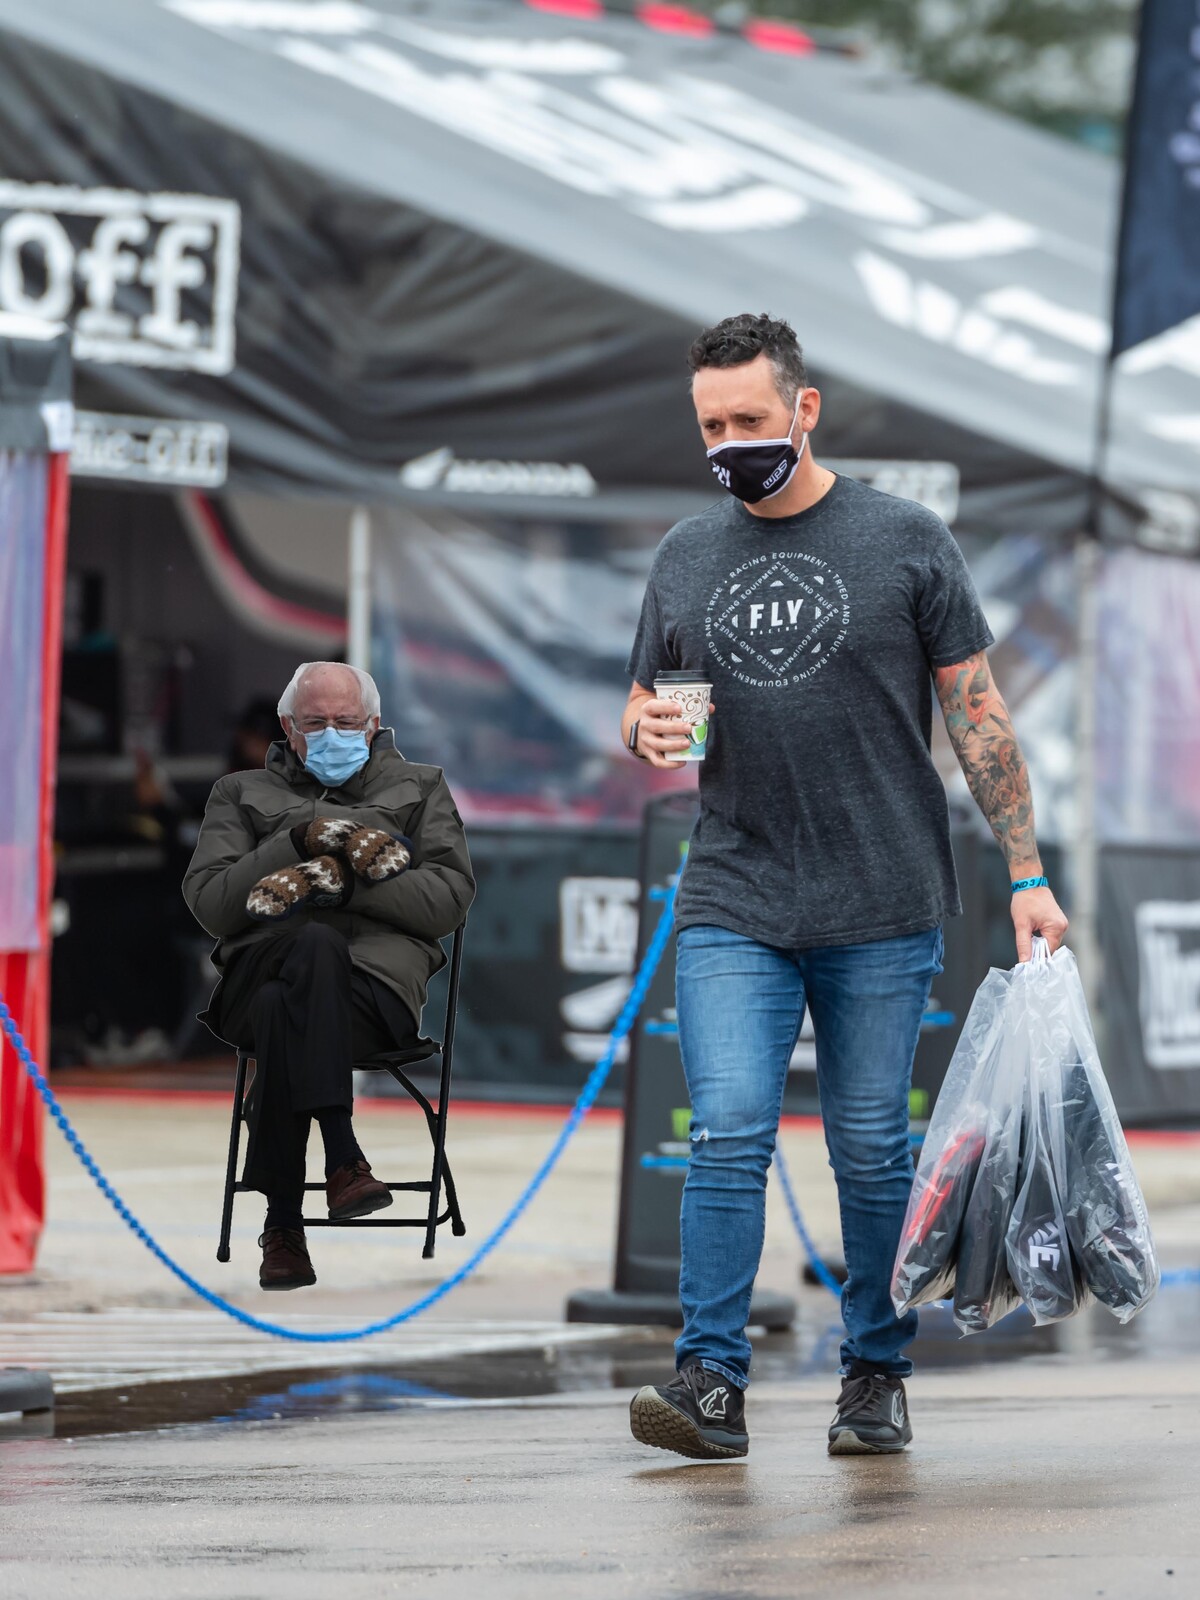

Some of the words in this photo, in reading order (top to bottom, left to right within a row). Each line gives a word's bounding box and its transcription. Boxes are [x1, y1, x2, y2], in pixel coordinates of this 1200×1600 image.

[729, 555, 768, 579] RACING
[772, 552, 828, 569] EQUIPMENT
[713, 600, 740, 628] RACING
[740, 561, 782, 600] EQUIPMENT
[780, 565, 800, 583] TRIED
[799, 581, 814, 595] AND
[813, 593, 834, 611] TRUE
[832, 573, 849, 600] TRIED
[707, 587, 723, 612] TRUE
[750, 599, 804, 630] FLY
[811, 608, 839, 634] RACING
[841, 604, 850, 625] AND
[718, 623, 738, 642] TRUE
[830, 629, 847, 653] TRUE
[708, 641, 727, 667] TRIED
[739, 640, 756, 655] AND
[775, 634, 812, 678] EQUIPMENT
[756, 654, 778, 675] TRIED
[793, 657, 828, 683] RACING
[732, 669, 789, 688] EQUIPMENT
